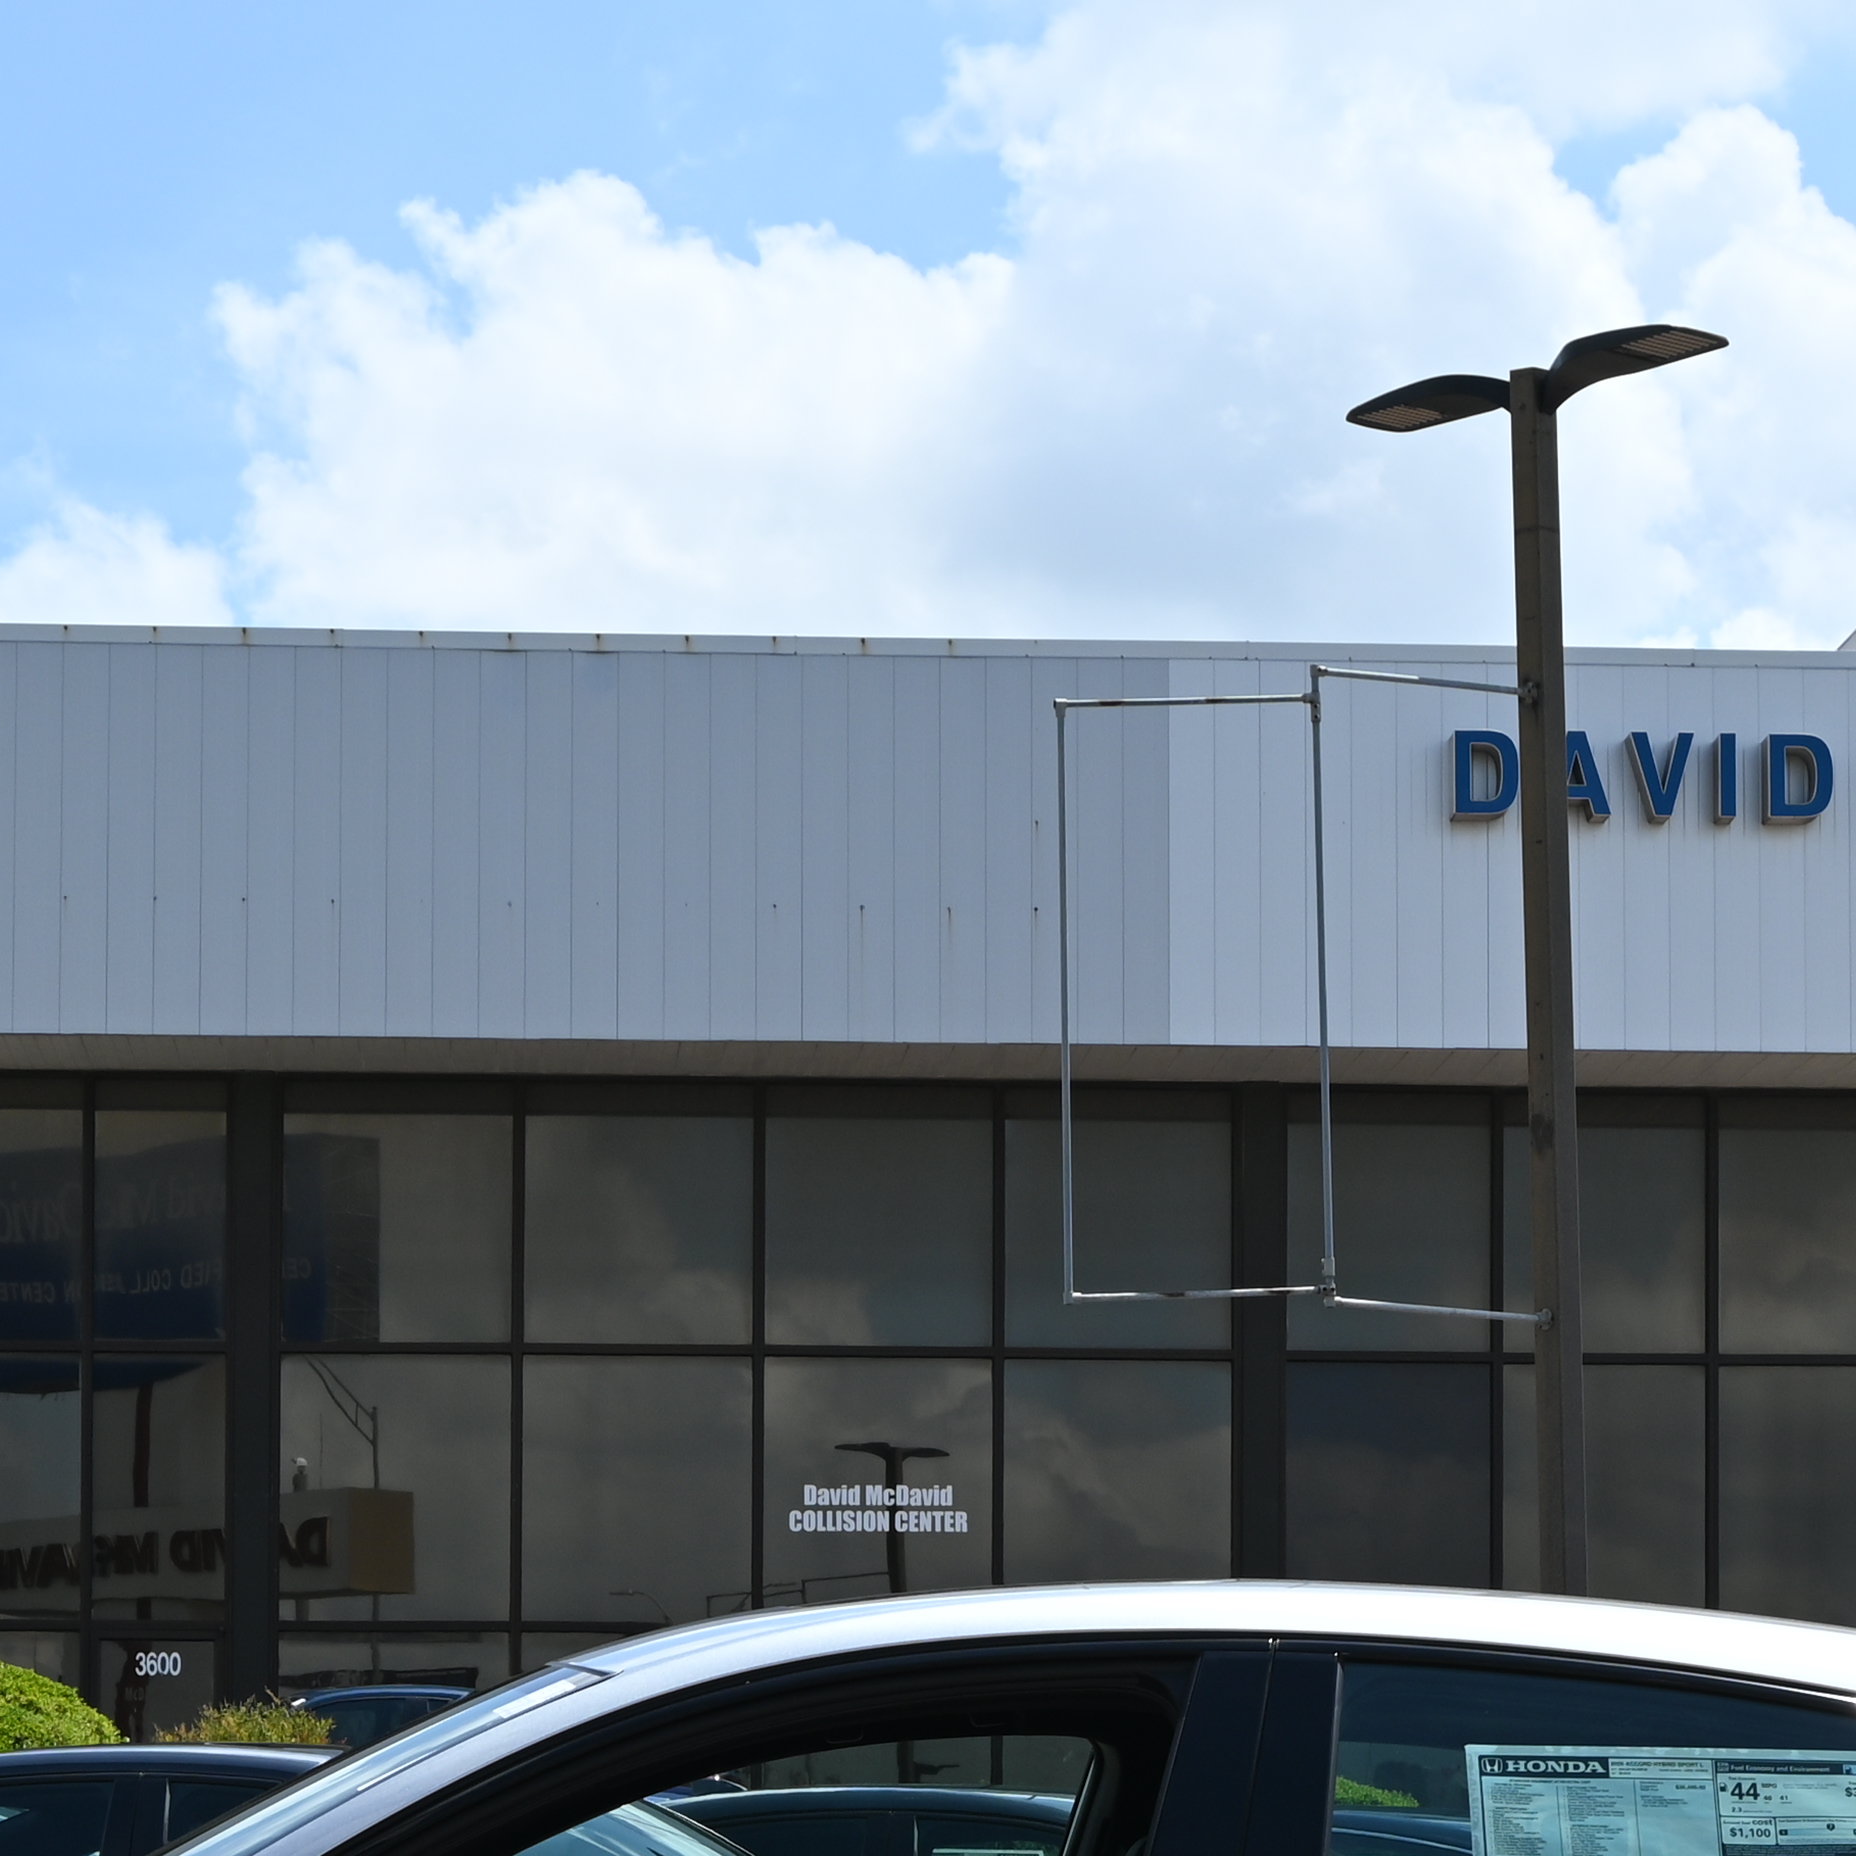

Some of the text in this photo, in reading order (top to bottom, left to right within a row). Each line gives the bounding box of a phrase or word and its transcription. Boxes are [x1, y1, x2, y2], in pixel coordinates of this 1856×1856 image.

[1450, 729, 1834, 825] DAVID
[803, 1484, 953, 1507] David McDavid
[788, 1510, 968, 1533] COLLISION CENTER
[134, 1651, 182, 1677] 3600
[1505, 1760, 1607, 1774] HONDA
[1730, 1782, 1760, 1801] 44
[1729, 1827, 1771, 1839] $1,100
